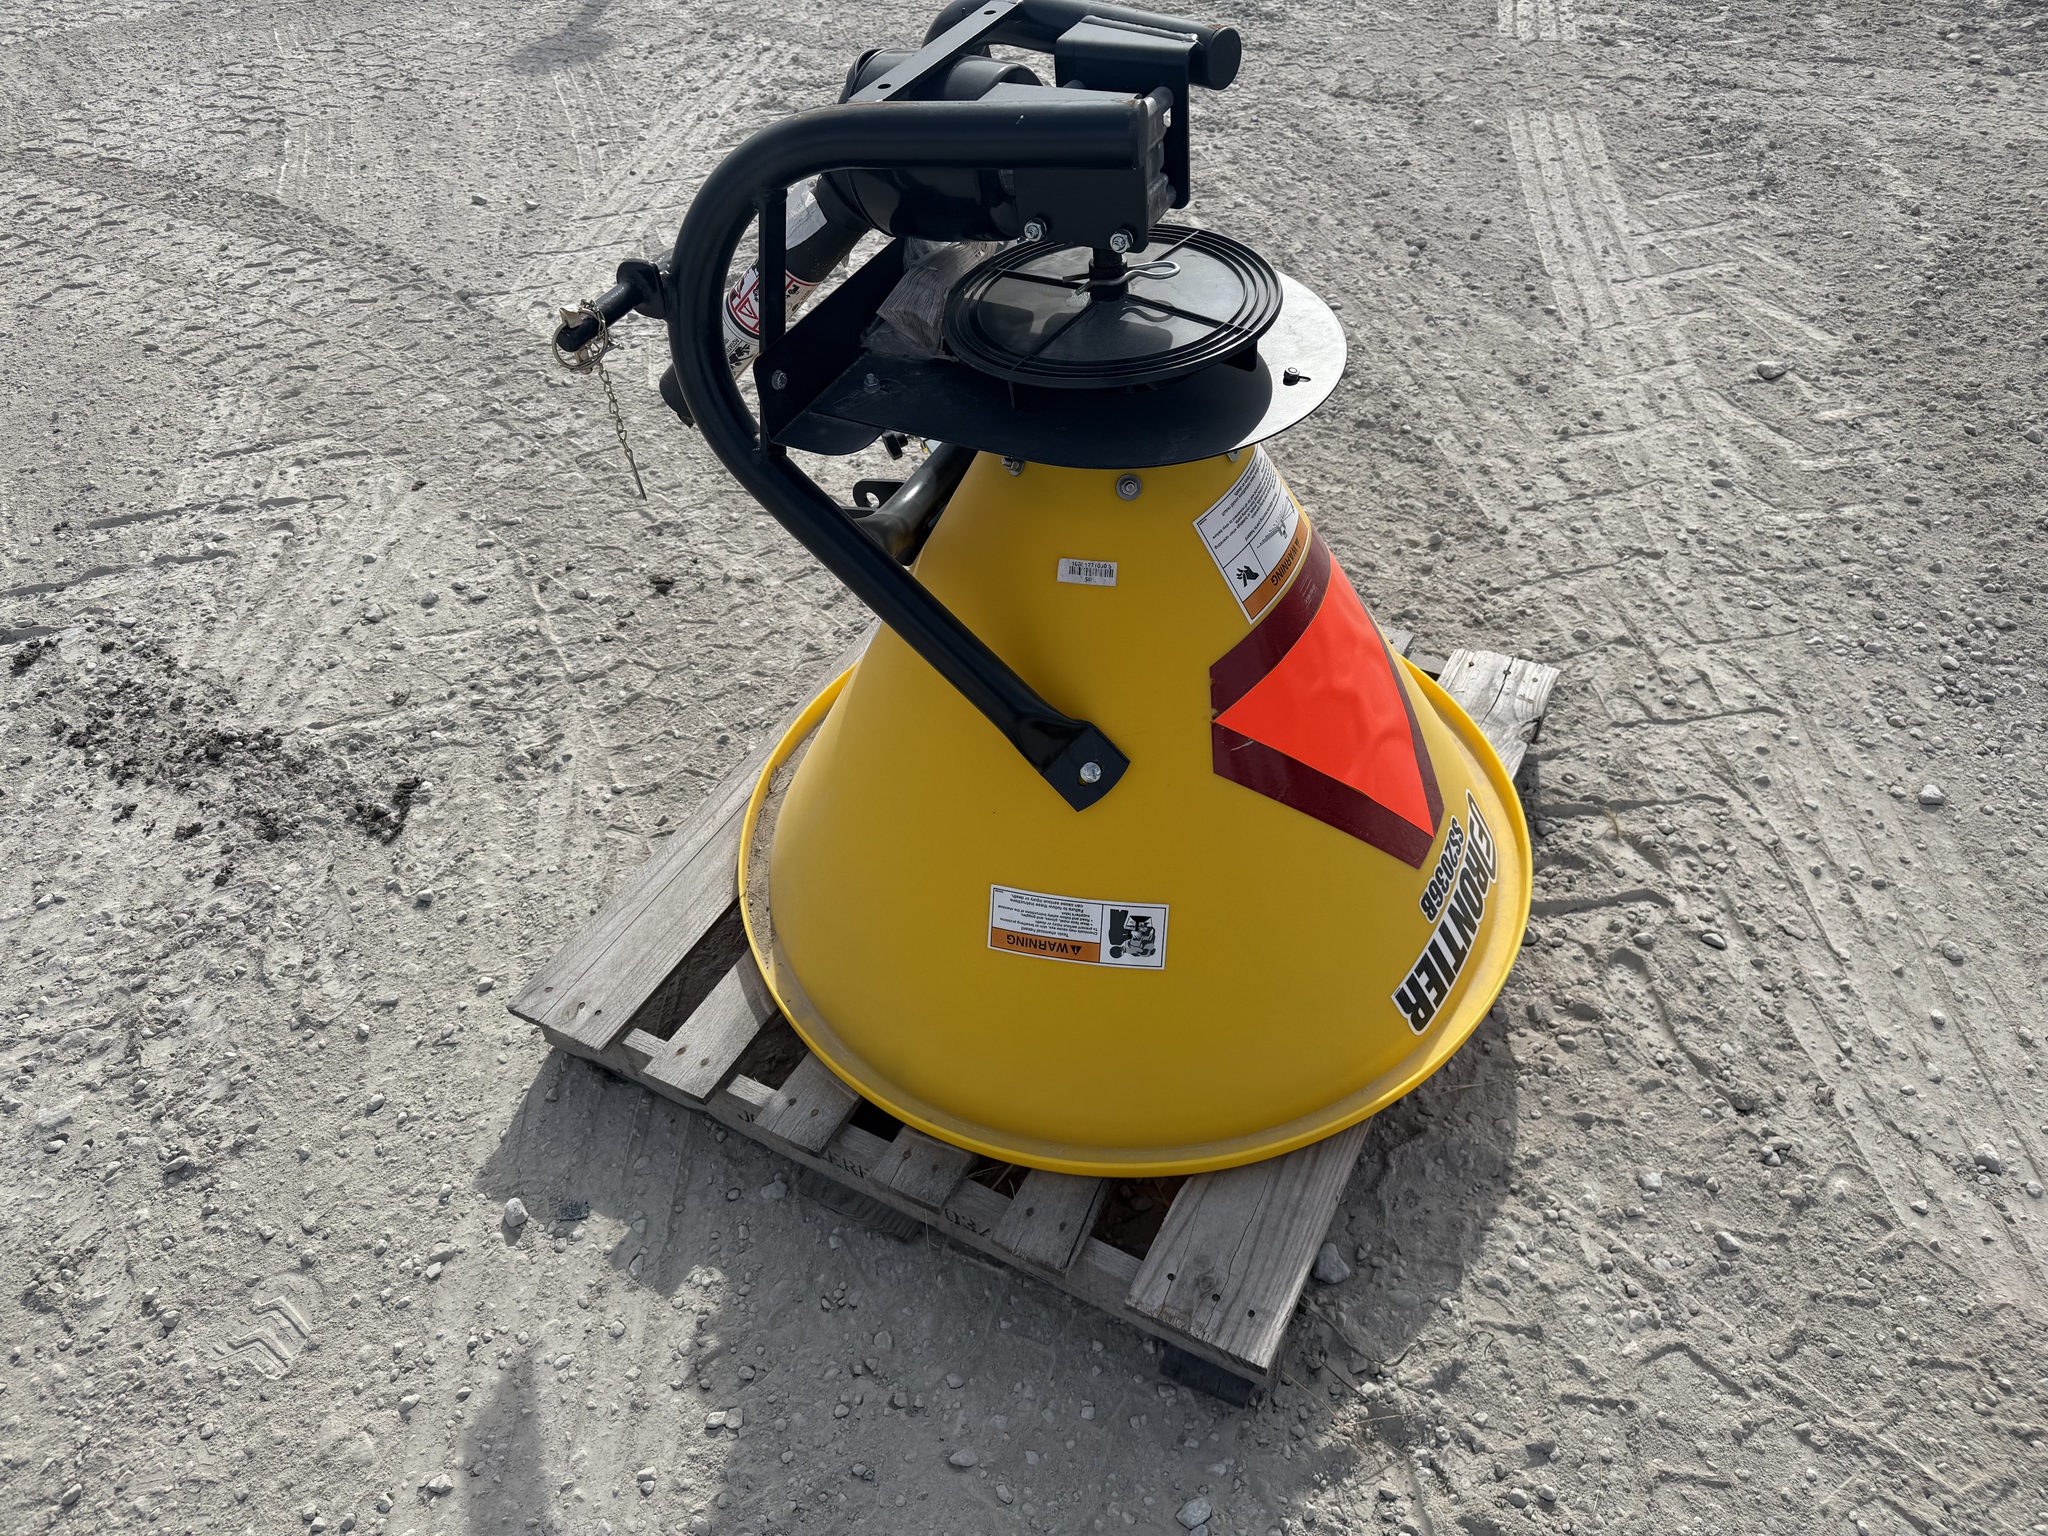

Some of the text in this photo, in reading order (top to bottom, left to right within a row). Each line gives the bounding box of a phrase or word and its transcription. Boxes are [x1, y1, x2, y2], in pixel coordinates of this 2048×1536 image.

[1271, 545, 1298, 586] WARNING
[1420, 816, 1464, 920] SS2036B
[1007, 934, 1068, 953] WARNING
[1393, 791, 1496, 1034] FRONTIER
